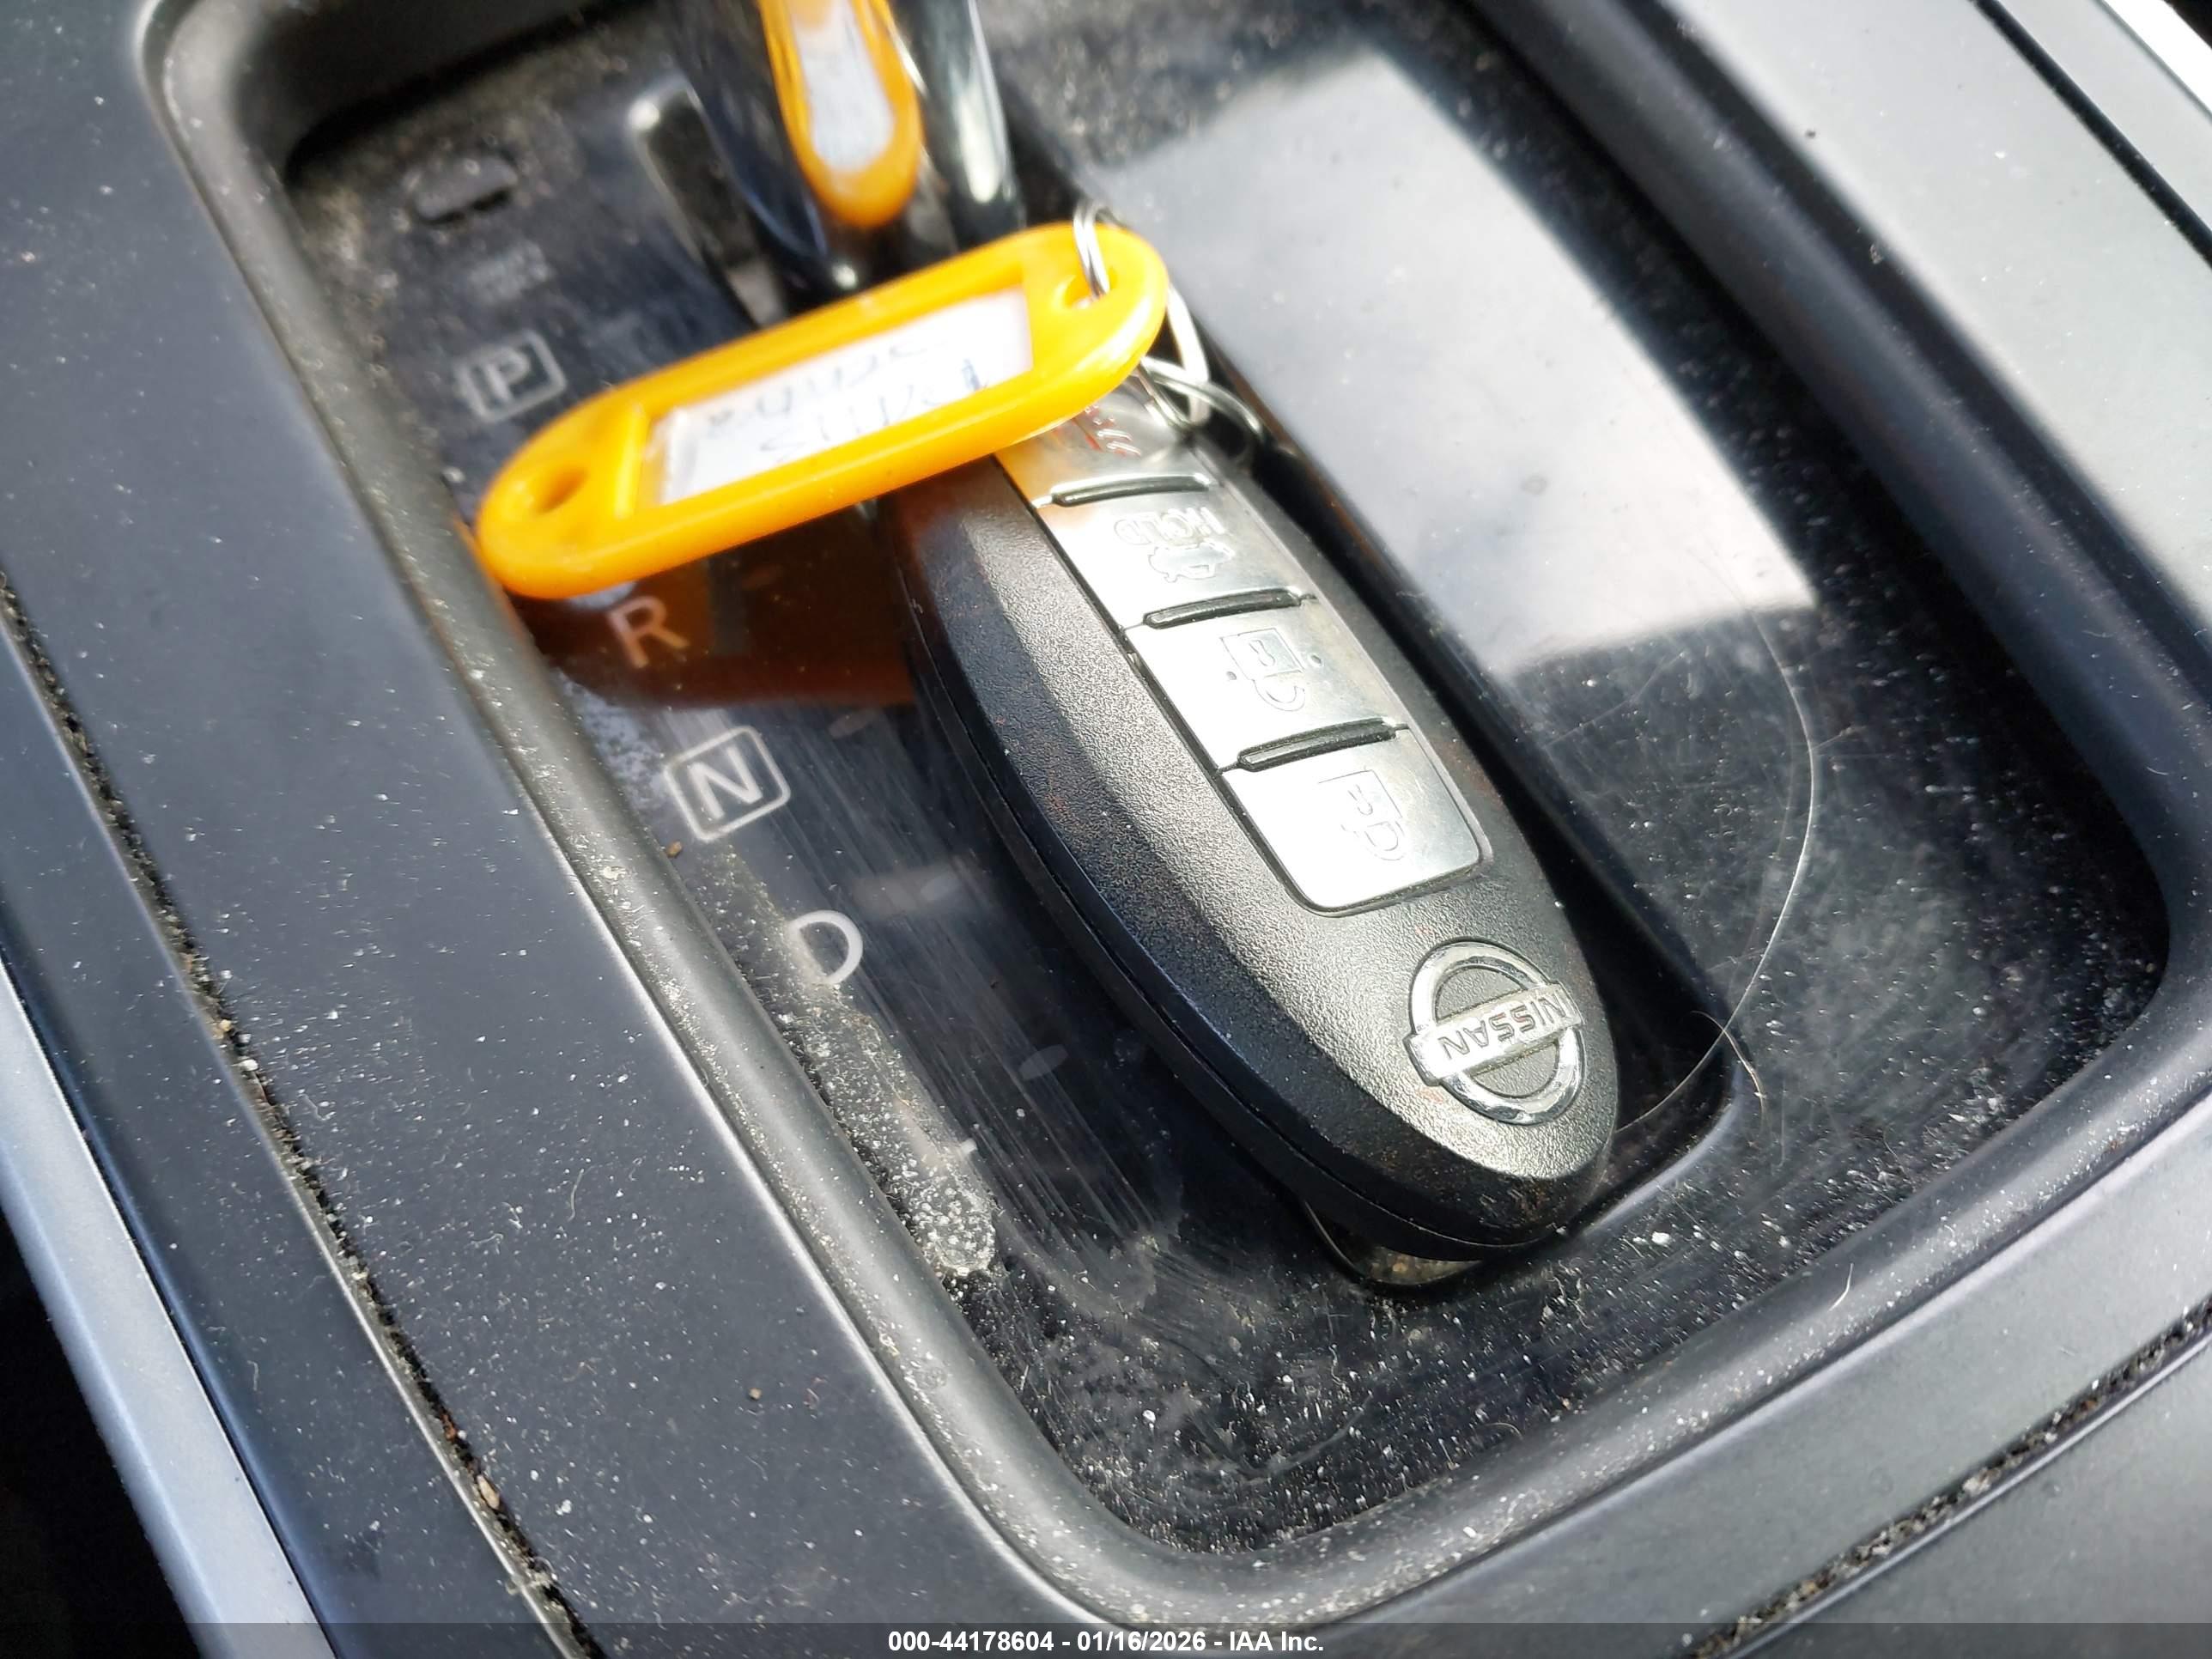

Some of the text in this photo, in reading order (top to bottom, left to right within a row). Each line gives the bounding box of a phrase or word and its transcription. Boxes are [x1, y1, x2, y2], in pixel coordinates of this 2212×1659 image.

[483, 345, 531, 403] P
[607, 595, 690, 669] R
[689, 744, 763, 819] N
[787, 909, 864, 985] D
[1437, 994, 1570, 1060] NISSAN
